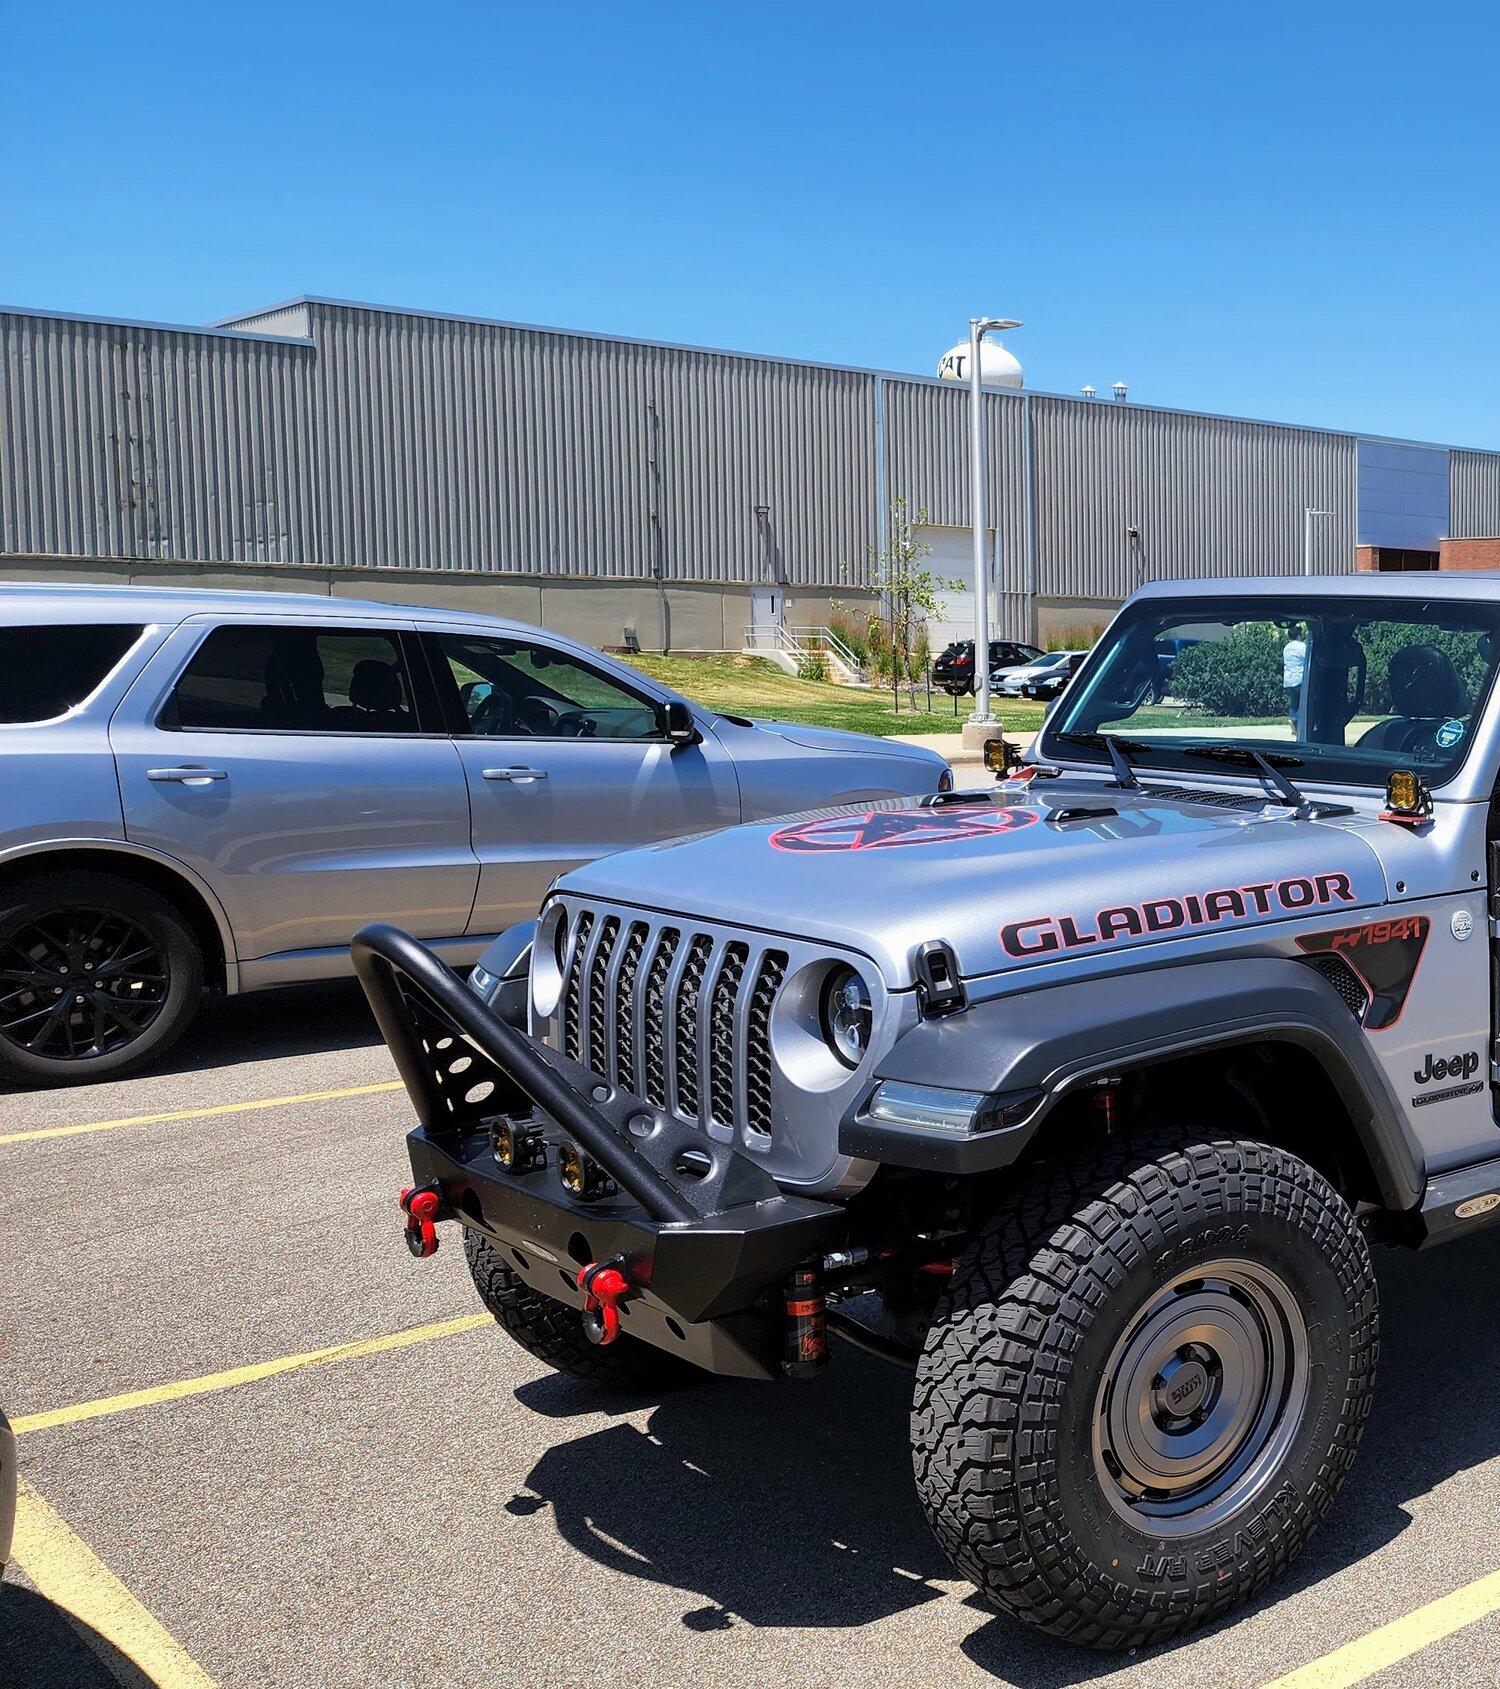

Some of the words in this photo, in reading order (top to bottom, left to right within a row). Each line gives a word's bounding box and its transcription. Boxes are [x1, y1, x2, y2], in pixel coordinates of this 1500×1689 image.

[938, 355, 966, 379] CAT
[1000, 872, 1357, 958] GLADIATOR
[1361, 916, 1421, 945] 1941
[1414, 1051, 1479, 1085] Jeep
[1416, 1086, 1468, 1106] GLADIATOR
[1193, 1480, 1299, 1575] KLEVER
